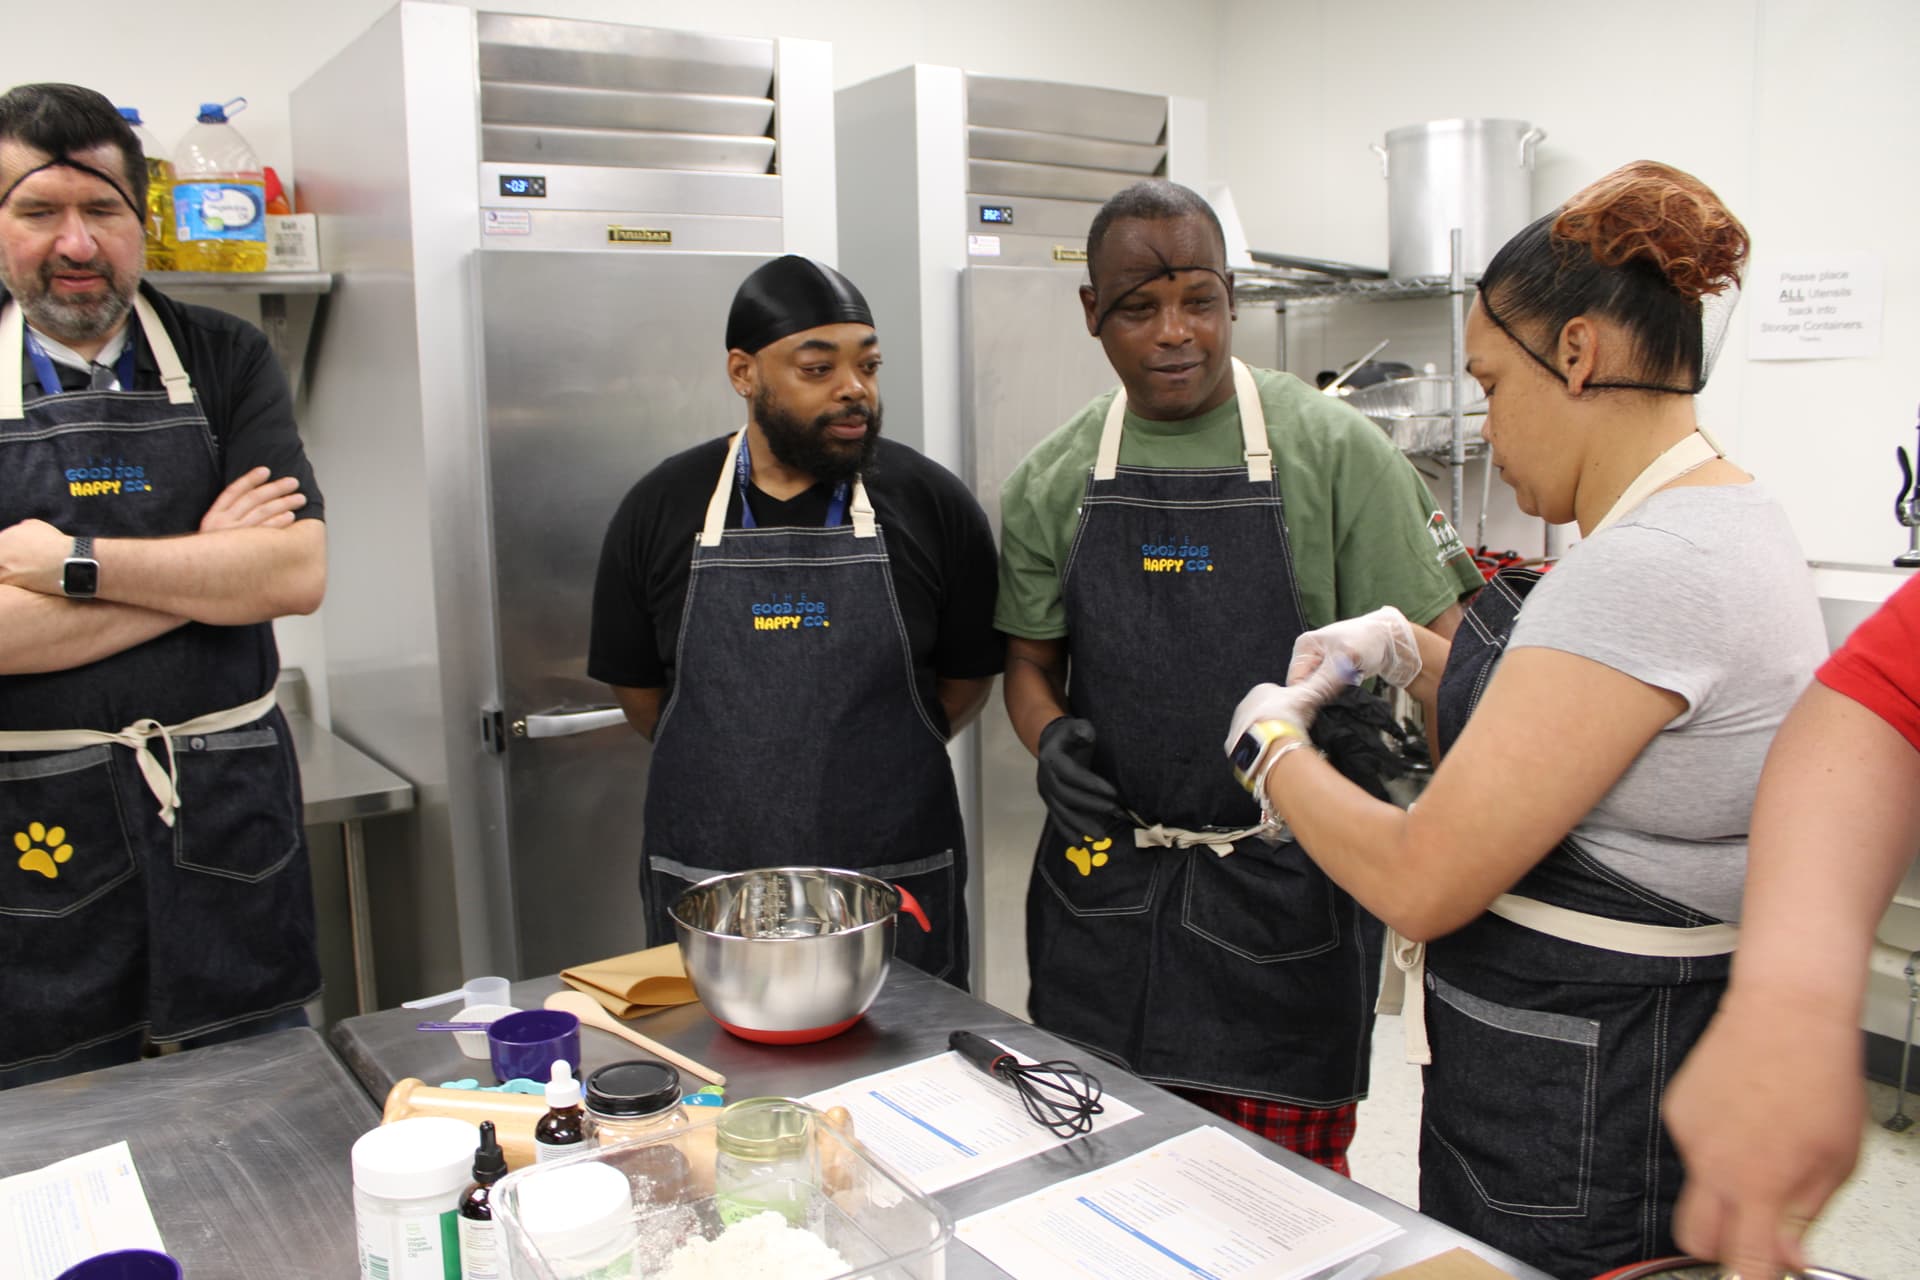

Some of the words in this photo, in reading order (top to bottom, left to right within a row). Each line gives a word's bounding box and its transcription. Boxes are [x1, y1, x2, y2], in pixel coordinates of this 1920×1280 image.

[1780, 271, 1816, 282] Please
[1818, 269, 1850, 282] place
[1779, 288, 1804, 300] ALL
[1808, 287, 1852, 299] Utensils
[1788, 306, 1813, 316] back
[1816, 305, 1837, 315] into
[1761, 322, 1801, 333] Storage
[65, 467, 113, 481] GOOD
[69, 480, 122, 497] HAPPY
[1141, 543, 1177, 557] GOOD
[1178, 545, 1210, 558] JOB
[1143, 557, 1185, 573] HAPPY
[751, 602, 793, 615] GOOD
[795, 601, 826, 614] JOB
[754, 615, 801, 631] HAPPY
